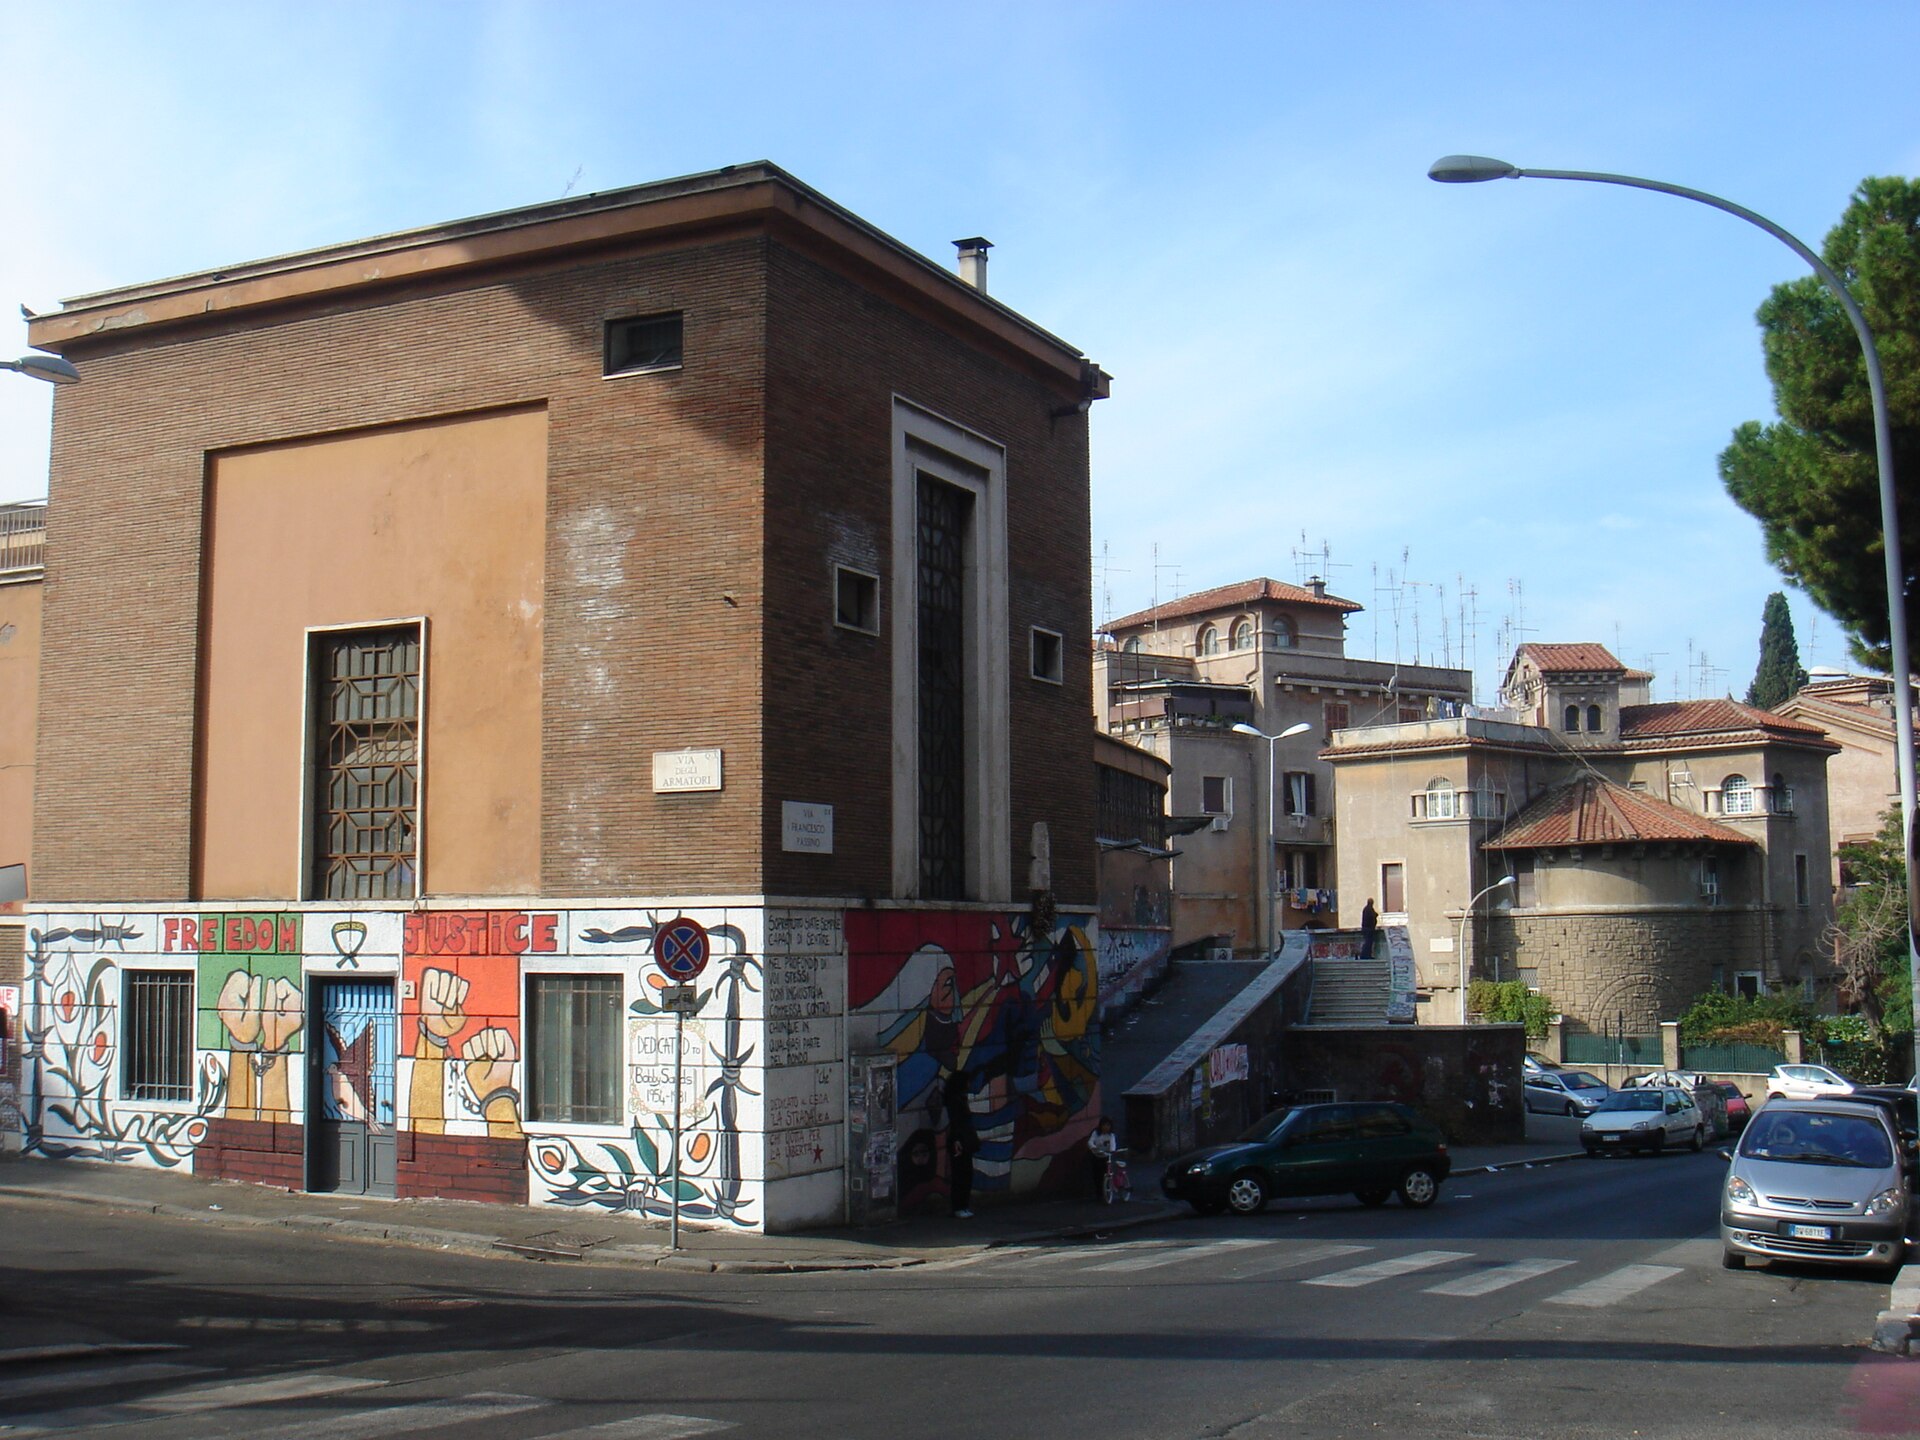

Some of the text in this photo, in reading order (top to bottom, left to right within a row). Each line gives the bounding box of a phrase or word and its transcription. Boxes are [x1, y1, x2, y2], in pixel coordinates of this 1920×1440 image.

[678, 756, 696, 766] VIA
[675, 767, 698, 776] DEGLI
[663, 776, 712, 788] ARMATORI
[163, 916, 297, 953] FREEDOM
[405, 984, 412, 995] 2
[692, 1046, 702, 1056] TO
[636, 1066, 693, 1088] Bobby Sads
